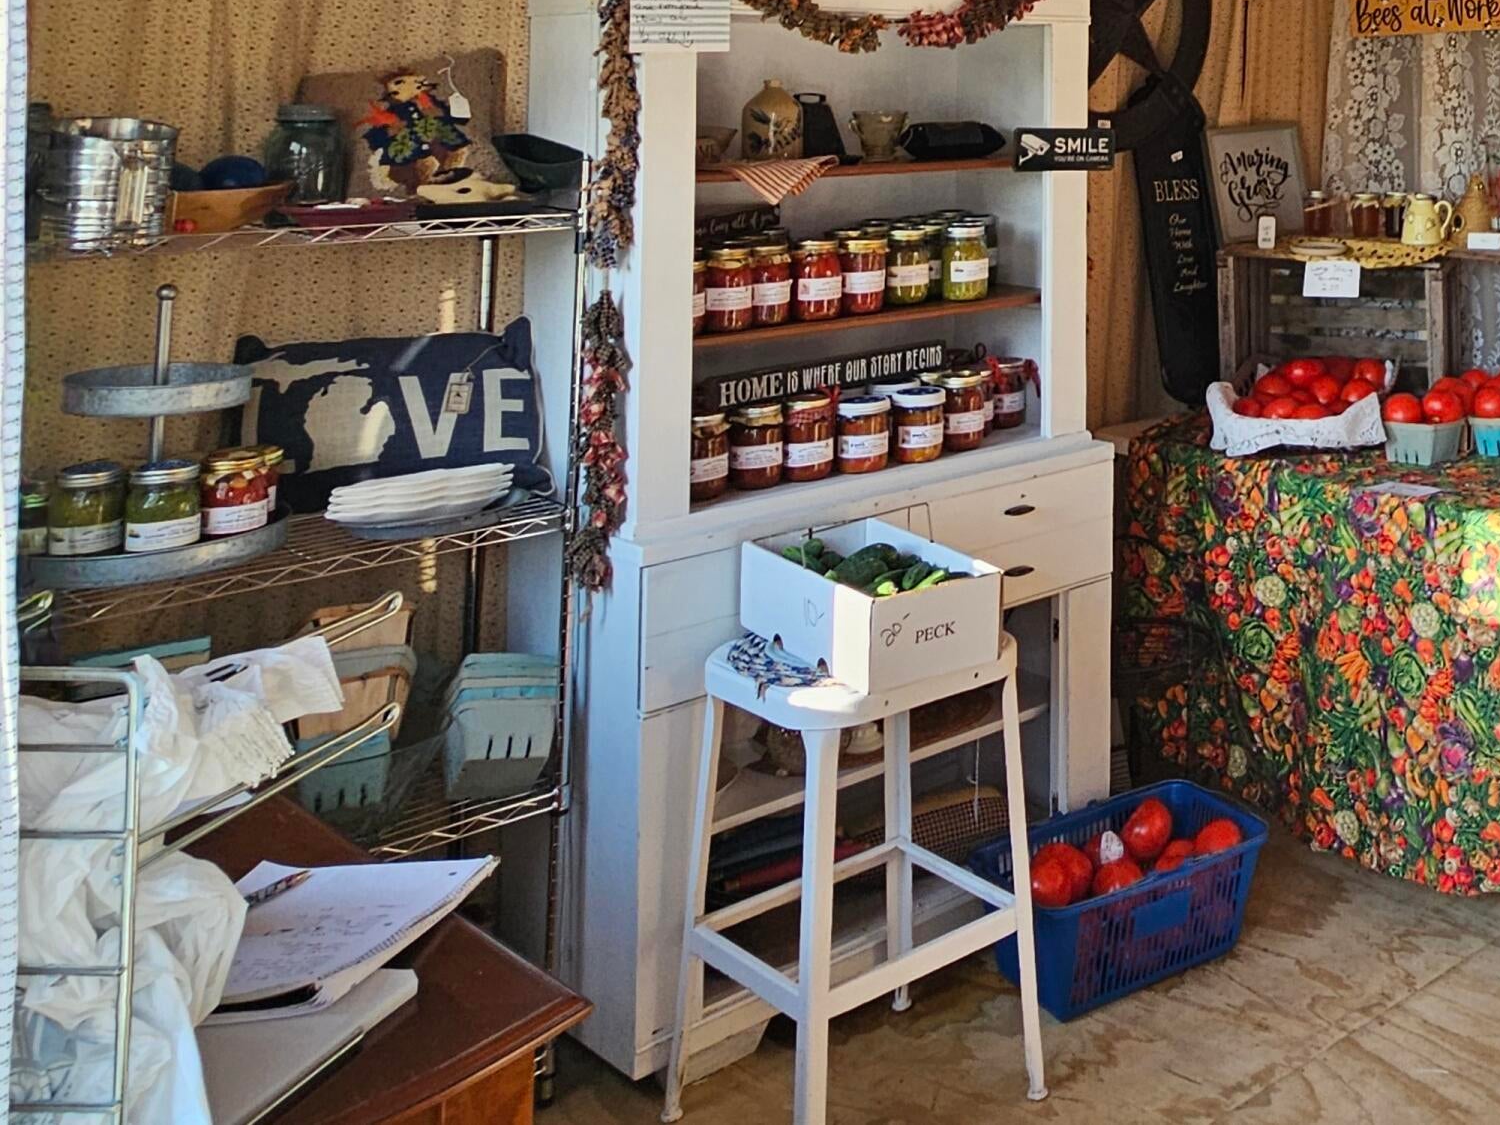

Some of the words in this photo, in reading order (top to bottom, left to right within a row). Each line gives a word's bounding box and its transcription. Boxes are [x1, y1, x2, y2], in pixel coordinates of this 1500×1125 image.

[1053, 137, 1110, 154] SMILE
[1053, 155, 1076, 163] YOU'RE
[1076, 155, 1085, 163] ON
[1086, 155, 1110, 163] CAMERA
[1219, 146, 1292, 187] Amazing
[1154, 178, 1200, 203] BLESS
[718, 372, 785, 408] HOME
[787, 370, 799, 393] IS
[802, 363, 842, 391] WHERE
[846, 357, 867, 382] OUR
[870, 351, 903, 377] STORY
[905, 345, 943, 371] BEGINS
[914, 621, 956, 644] PECK
